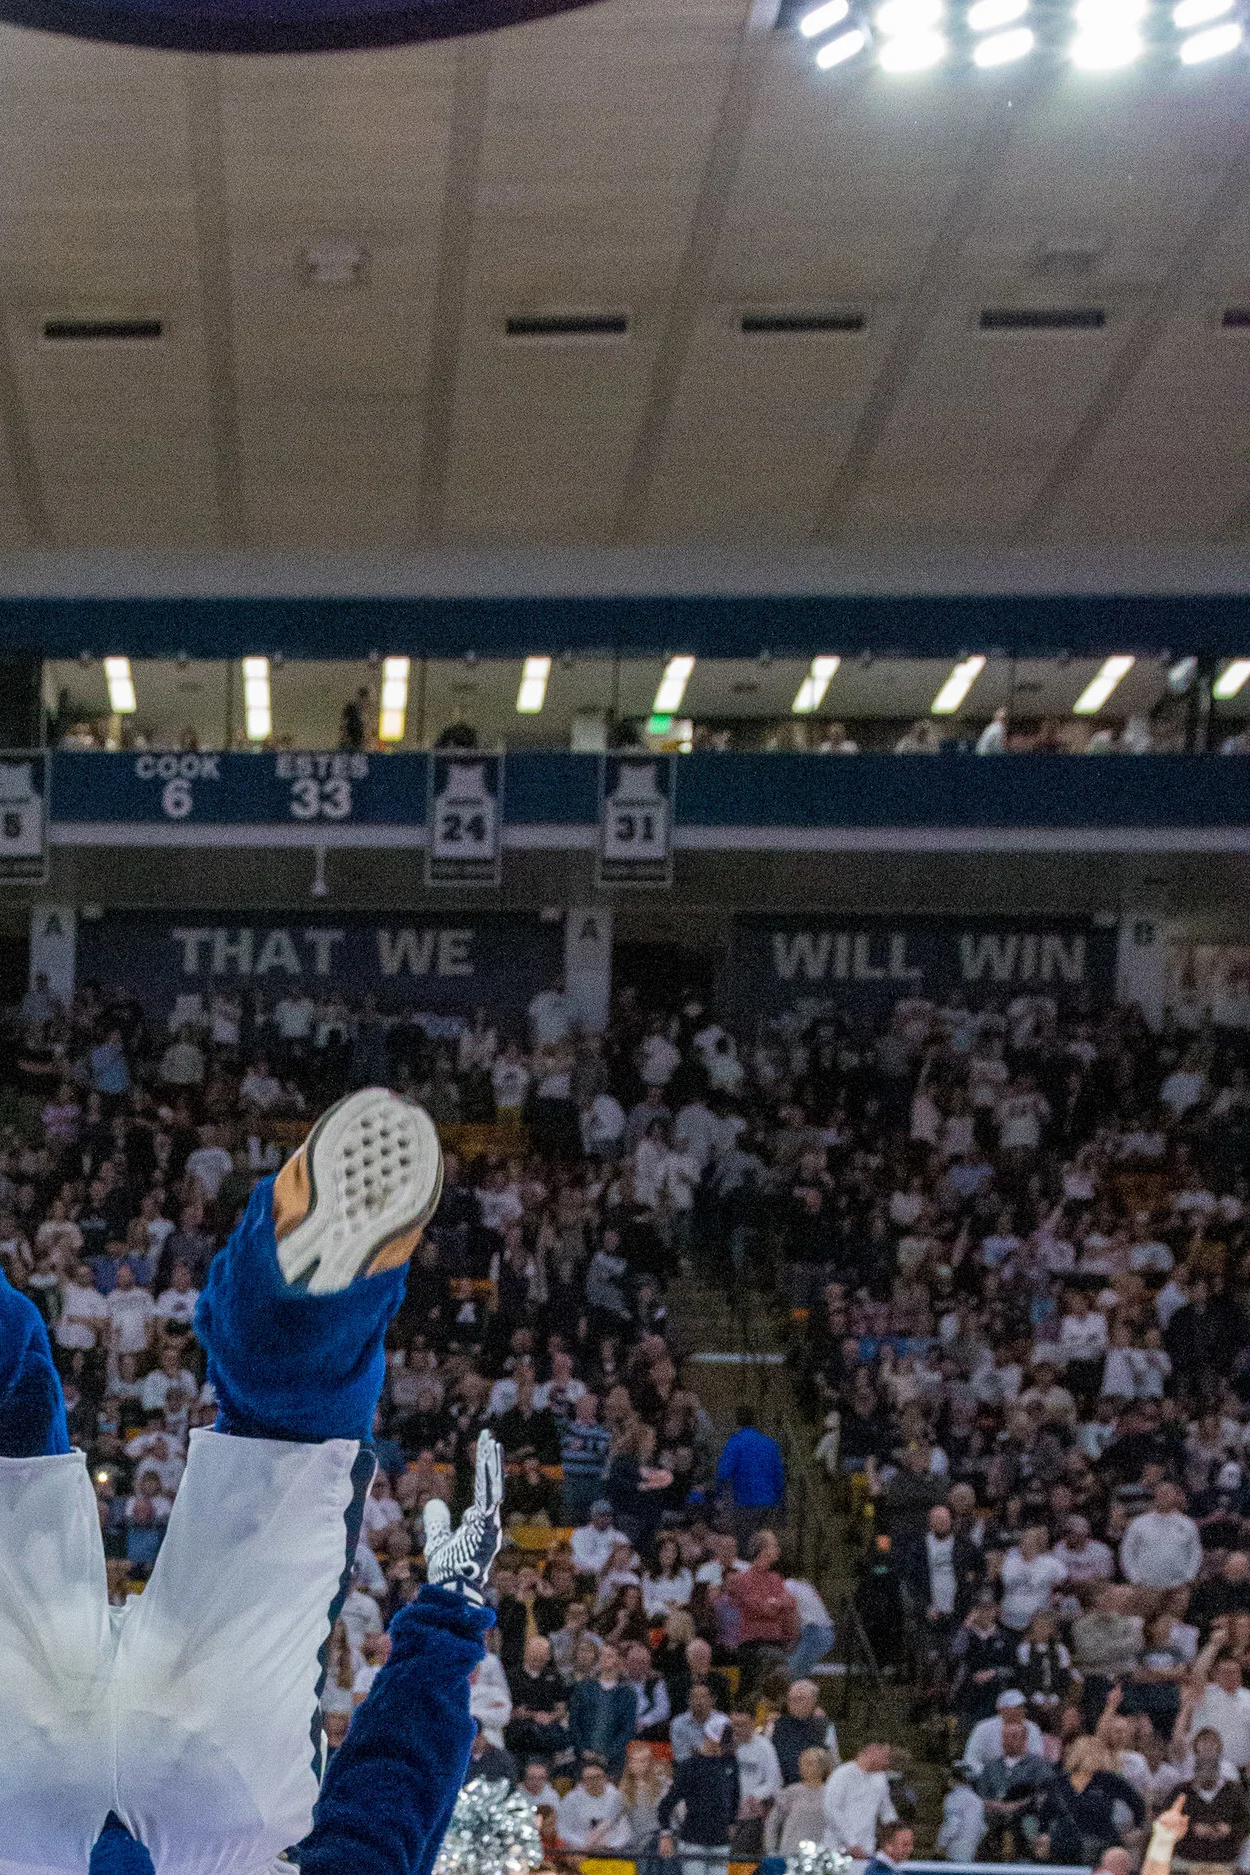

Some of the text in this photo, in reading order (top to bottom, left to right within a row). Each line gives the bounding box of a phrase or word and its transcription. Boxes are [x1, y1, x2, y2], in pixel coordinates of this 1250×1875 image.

[135, 754, 221, 780] COOK
[276, 753, 369, 779] ESTES
[162, 778, 193, 819] 6
[290, 778, 352, 820] 33
[442, 813, 486, 842] 24
[616, 813, 654, 842] 31
[172, 928, 474, 976] THAT WE
[771, 931, 1086, 983] WILL WIN
